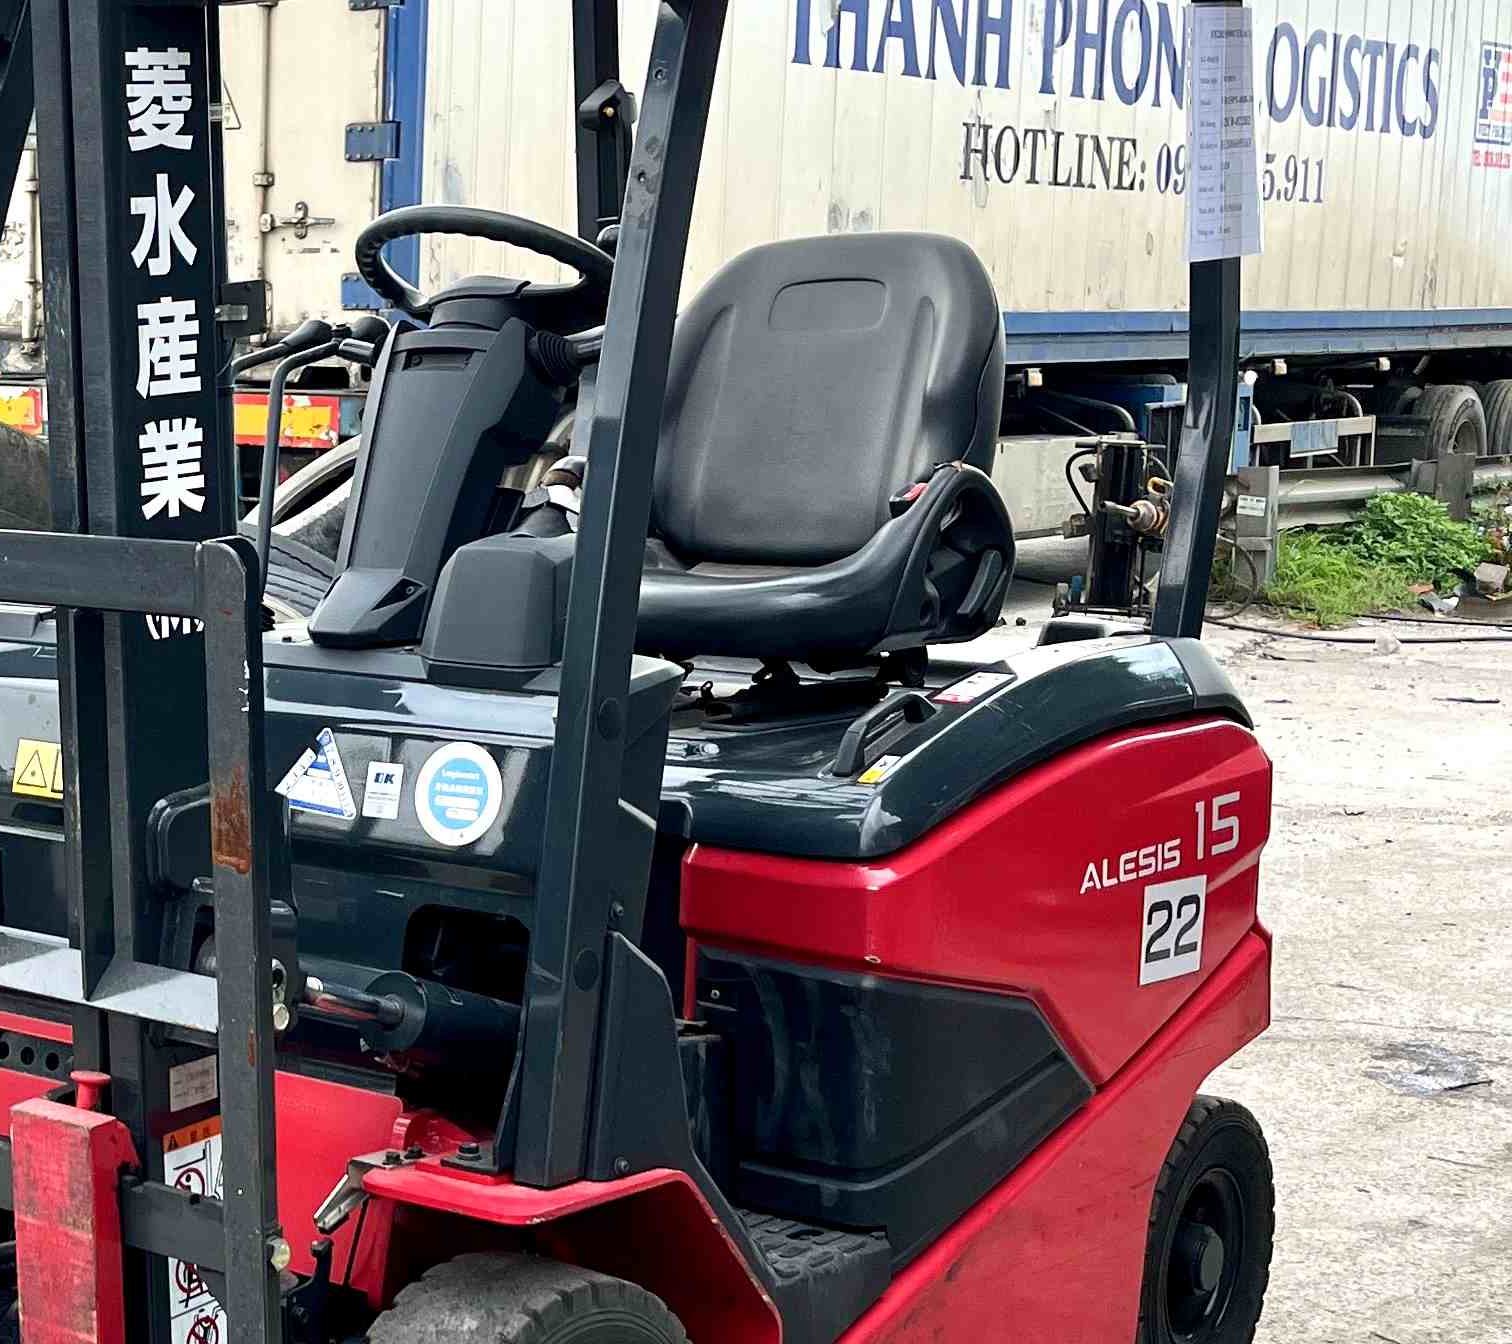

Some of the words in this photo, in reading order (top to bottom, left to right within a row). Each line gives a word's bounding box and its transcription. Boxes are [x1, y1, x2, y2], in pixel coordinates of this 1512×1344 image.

[1259, 22, 1440, 140] OGISTICS
[960, 120, 1146, 193] HOTLINE:
[123, 46, 208, 641] 菱水産業
[1079, 837, 1182, 895] ALESIS
[1194, 791, 1240, 860] 15
[1144, 894, 1201, 964] 22
